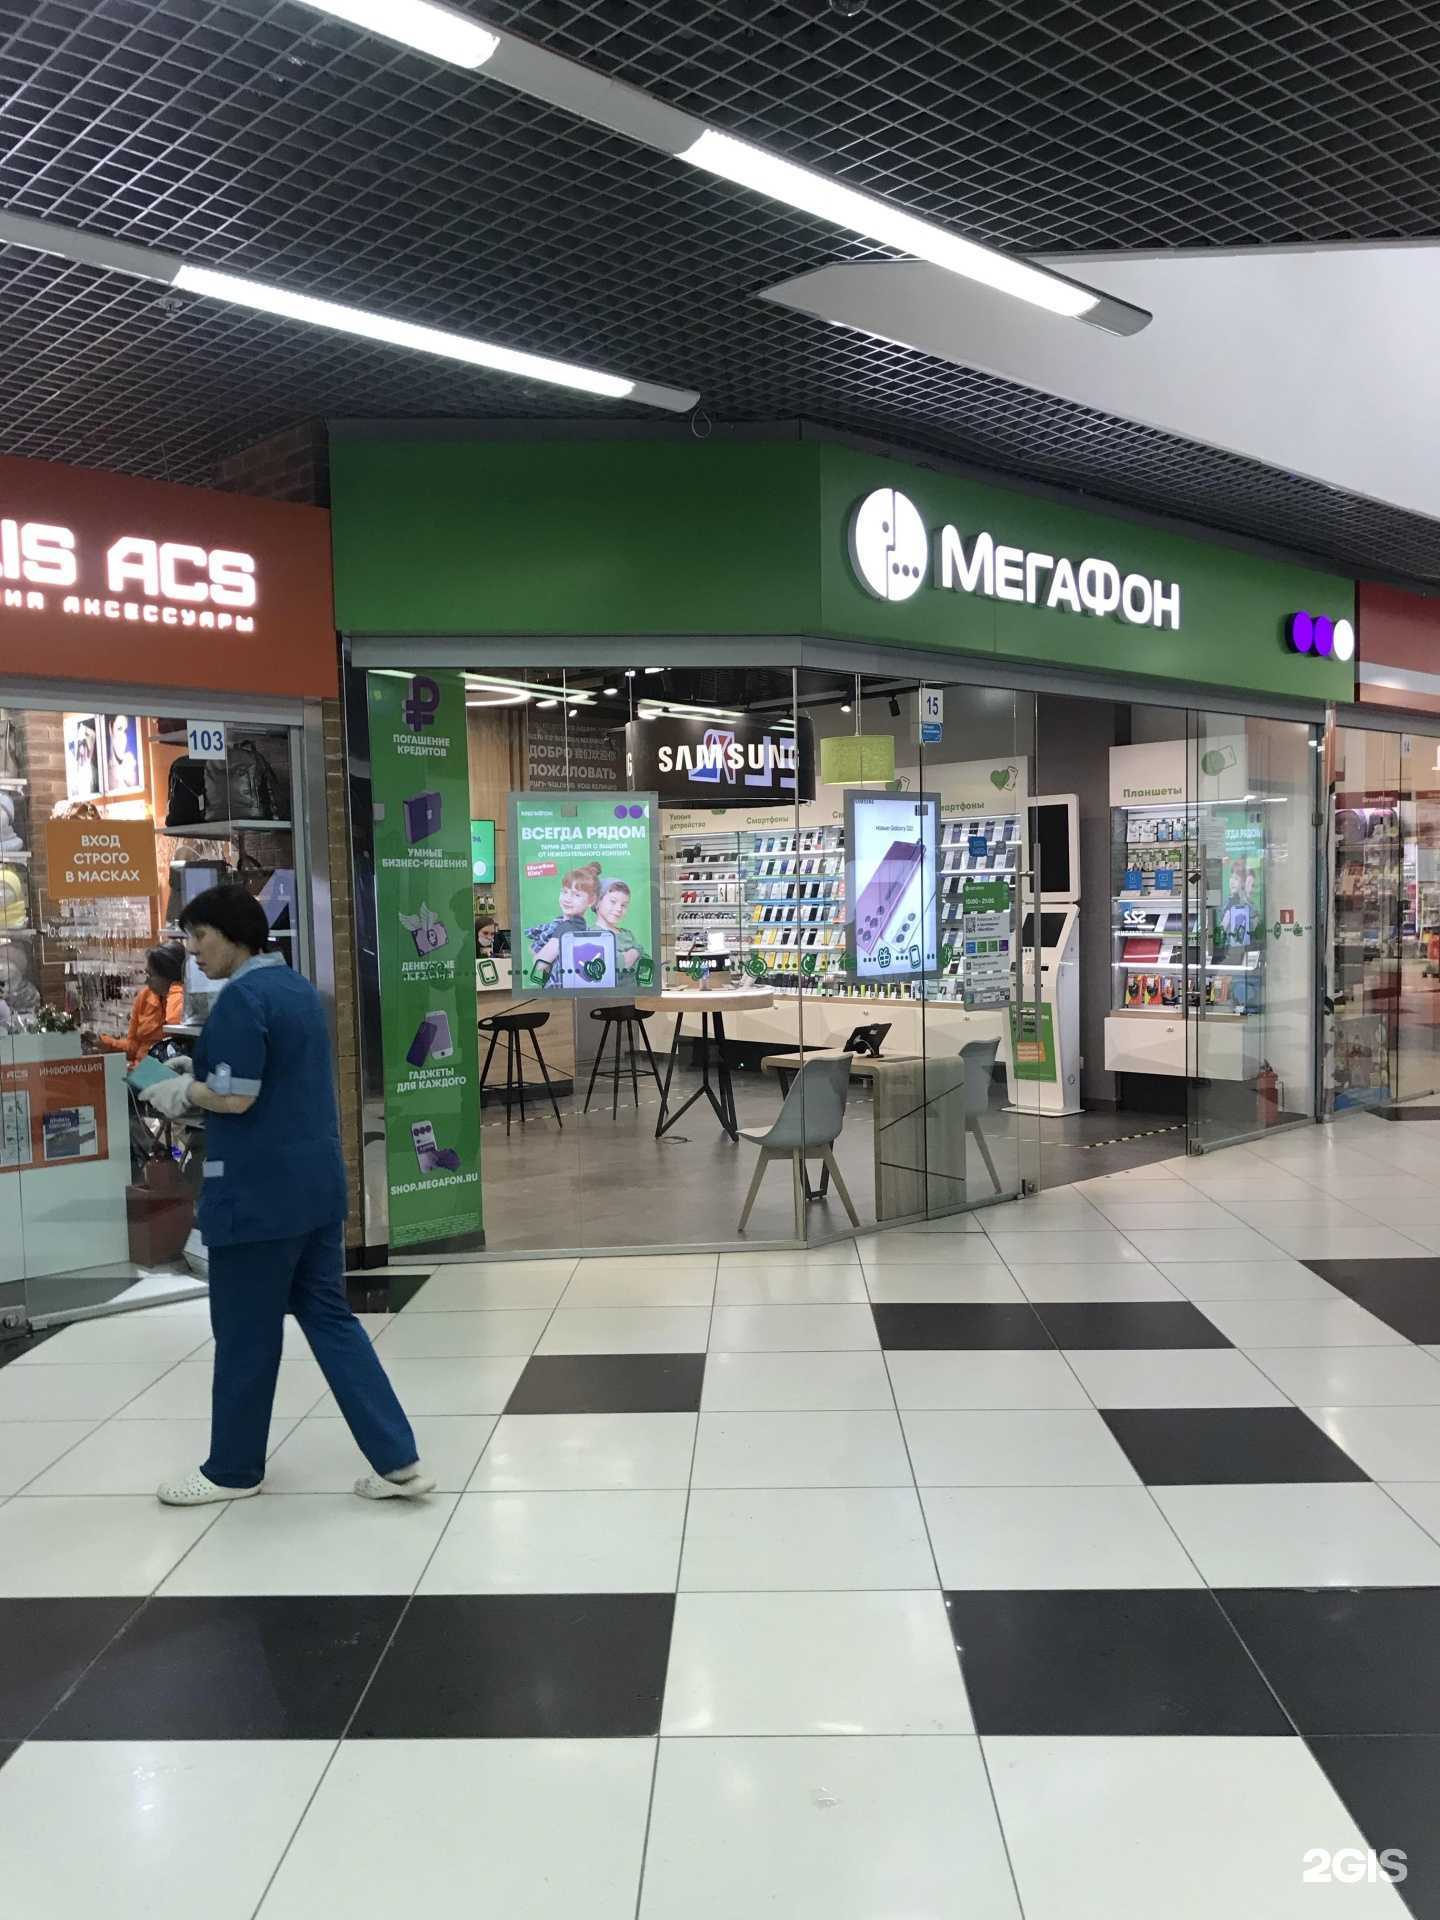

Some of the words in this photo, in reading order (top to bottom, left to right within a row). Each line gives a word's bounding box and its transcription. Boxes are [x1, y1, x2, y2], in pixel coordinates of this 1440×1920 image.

[0, 518, 77, 586] IS
[107, 536, 256, 607] ACS
[63, 596, 254, 632] АКСЕССУАРЫ
[927, 696, 939, 715] 15
[190, 730, 224, 751] 103
[393, 733, 451, 747] ПОГАШЕНИЕ
[397, 745, 447, 757] КРЕДИТОВ
[529, 744, 573, 759] ДОБРО
[529, 763, 617, 780] ПОЖАЛОВАТЬ
[1123, 787, 1183, 798] Планшеты
[746, 816, 789, 826] Смартфоны
[521, 827, 583, 841] ВСЕГДА
[586, 826, 646, 840] РЯДОМ
[81, 835, 121, 848] ВХОД
[73, 852, 130, 865] СТРОГО
[408, 848, 443, 858] УМНЫЕ
[382, 858, 468, 869] БИЗНЕС-РЕШЕНИЯ
[65, 872, 75, 882] В
[78, 870, 140, 882] МАСКАХ
[39, 1063, 103, 1077] ИНФОРМАЦИЯ
[408, 1068, 454, 1080] ГАДЖЕТЫ
[396, 1082, 417, 1093] ДЛЯ
[419, 1077, 466, 1089] КАЖДОГО
[390, 1172, 478, 1196] SHOP.MEGAFON.RU
